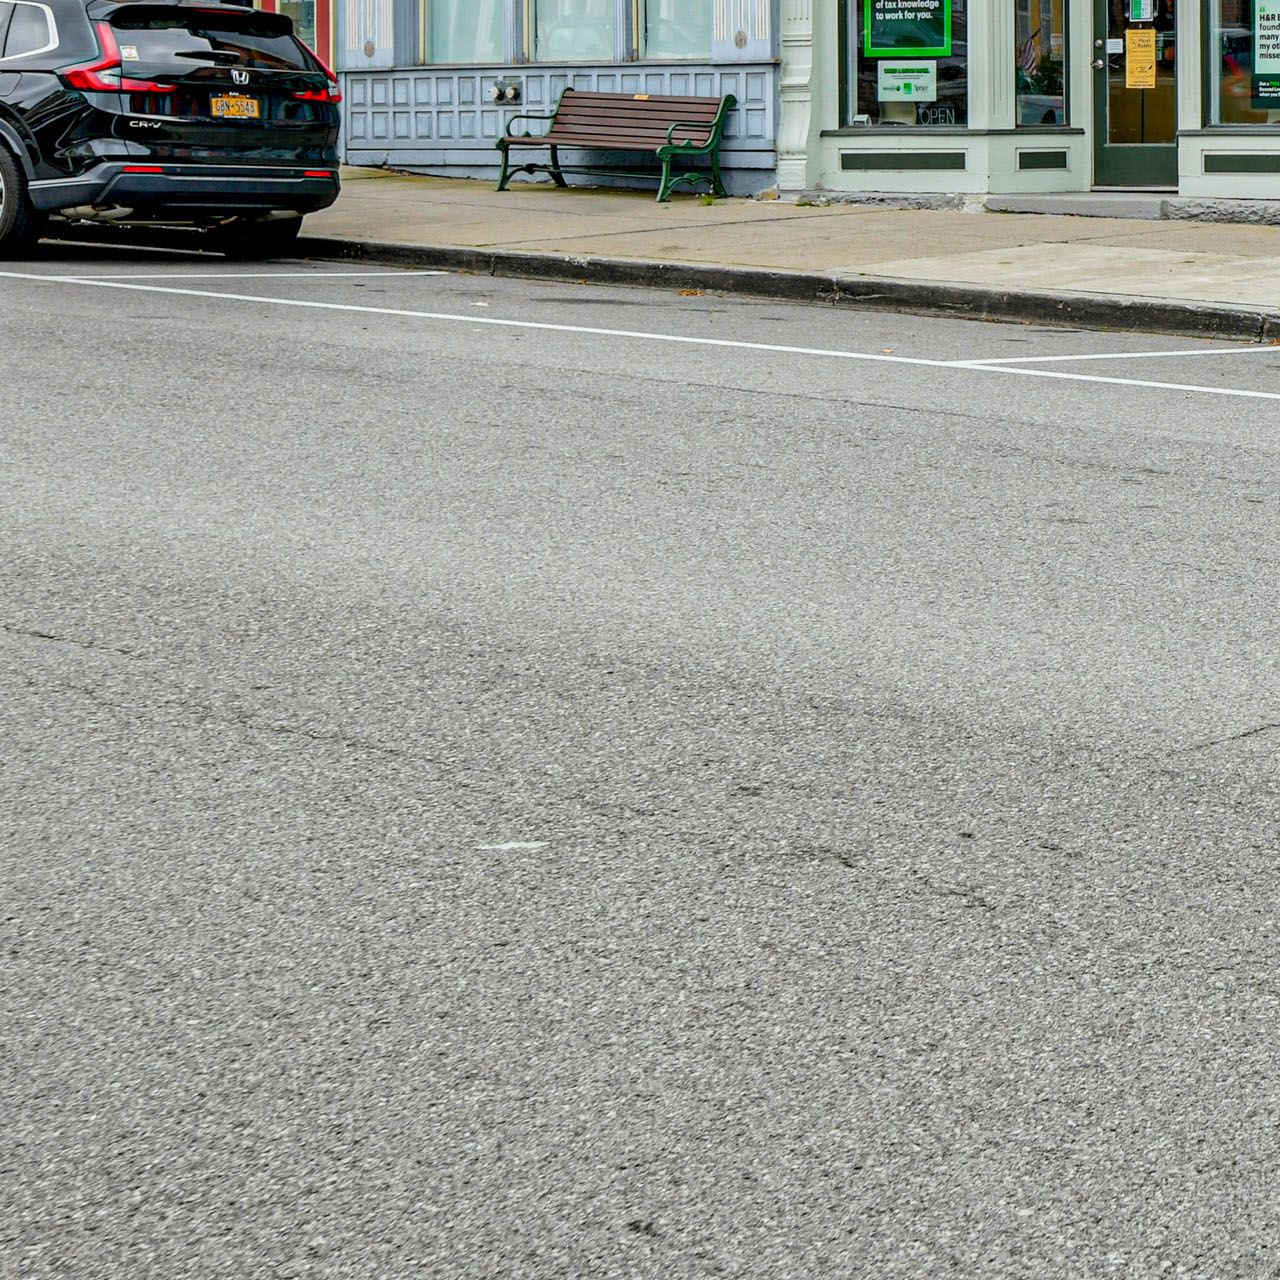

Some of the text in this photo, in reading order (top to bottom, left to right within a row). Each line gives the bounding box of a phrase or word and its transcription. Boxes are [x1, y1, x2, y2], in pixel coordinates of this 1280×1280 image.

[876, 0, 939, 9] of tax knowledge
[876, 10, 933, 21] to work for you.
[1259, 23, 1280, 31] found
[1259, 34, 1279, 42] many
[919, 108, 955, 125] OPEN
[129, 120, 162, 129] CR-V
